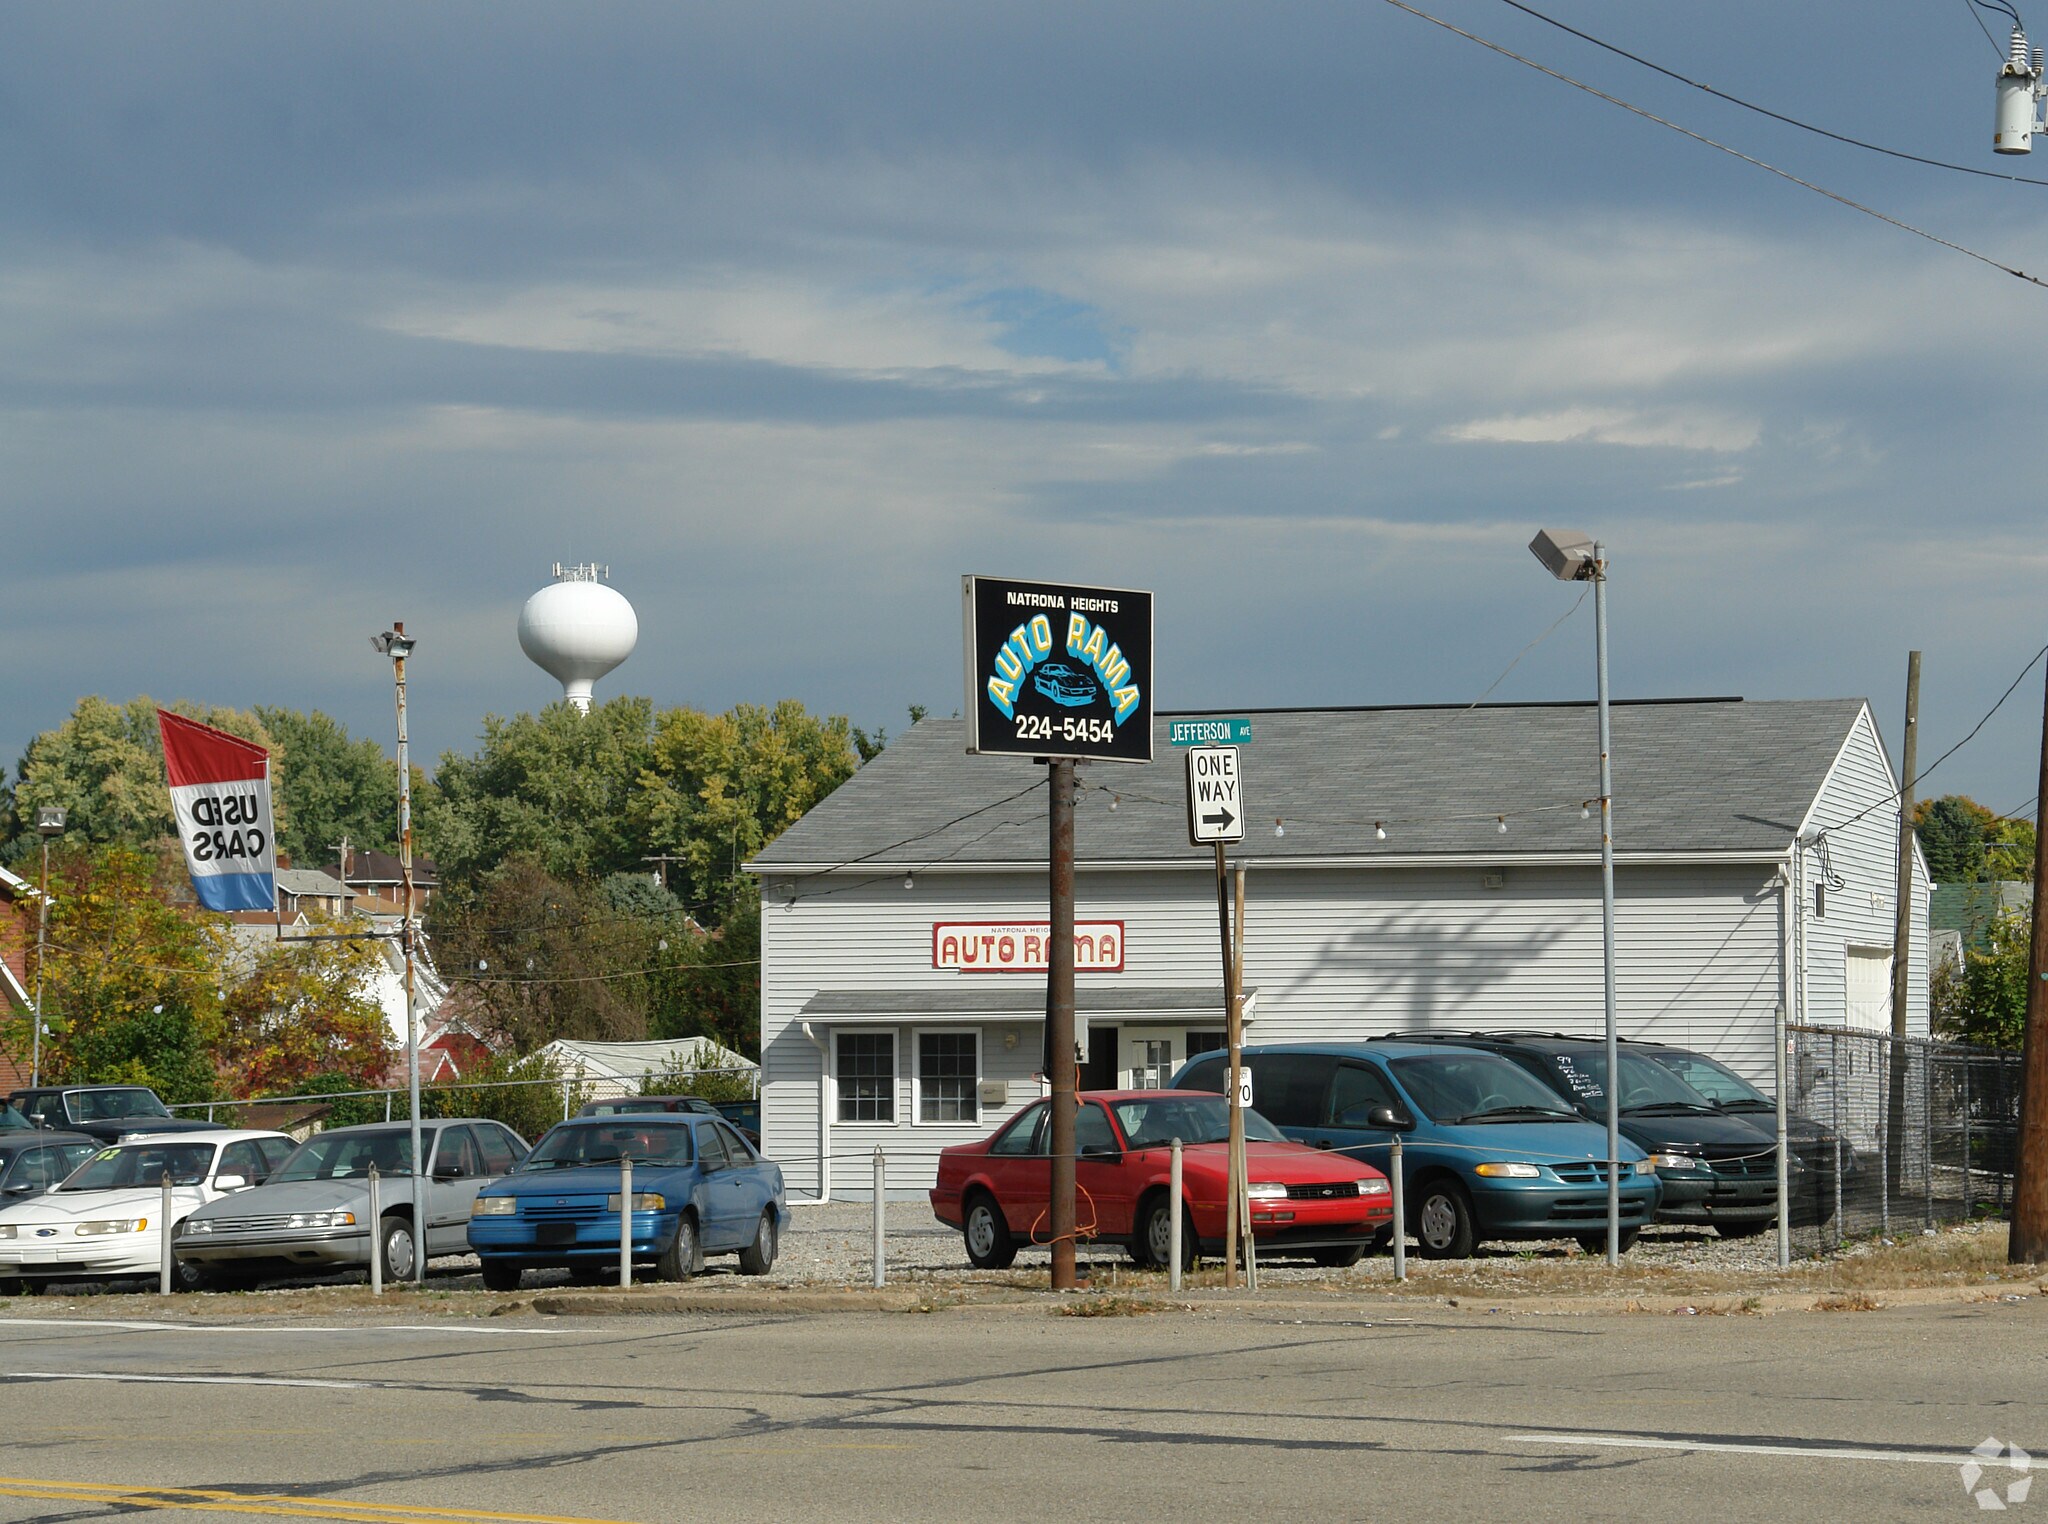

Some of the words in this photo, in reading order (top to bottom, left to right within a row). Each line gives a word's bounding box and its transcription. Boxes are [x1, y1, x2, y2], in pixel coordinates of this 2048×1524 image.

[1007, 592, 1065, 609] NATRONA
[1071, 597, 1119, 613] HEIGHTS
[987, 613, 1052, 721] AUTO
[1066, 611, 1140, 727] RAMA
[1015, 715, 1113, 743] 224-5454
[1171, 723, 1231, 742] JEFFERSON
[1240, 726, 1250, 736] AVE
[1197, 755, 1233, 776] ONE
[1198, 780, 1235, 802] WAY
[942, 936, 1015, 963] AUTO
[1556, 1056, 1571, 1064] 99
[95, 1149, 121, 1161] 92
